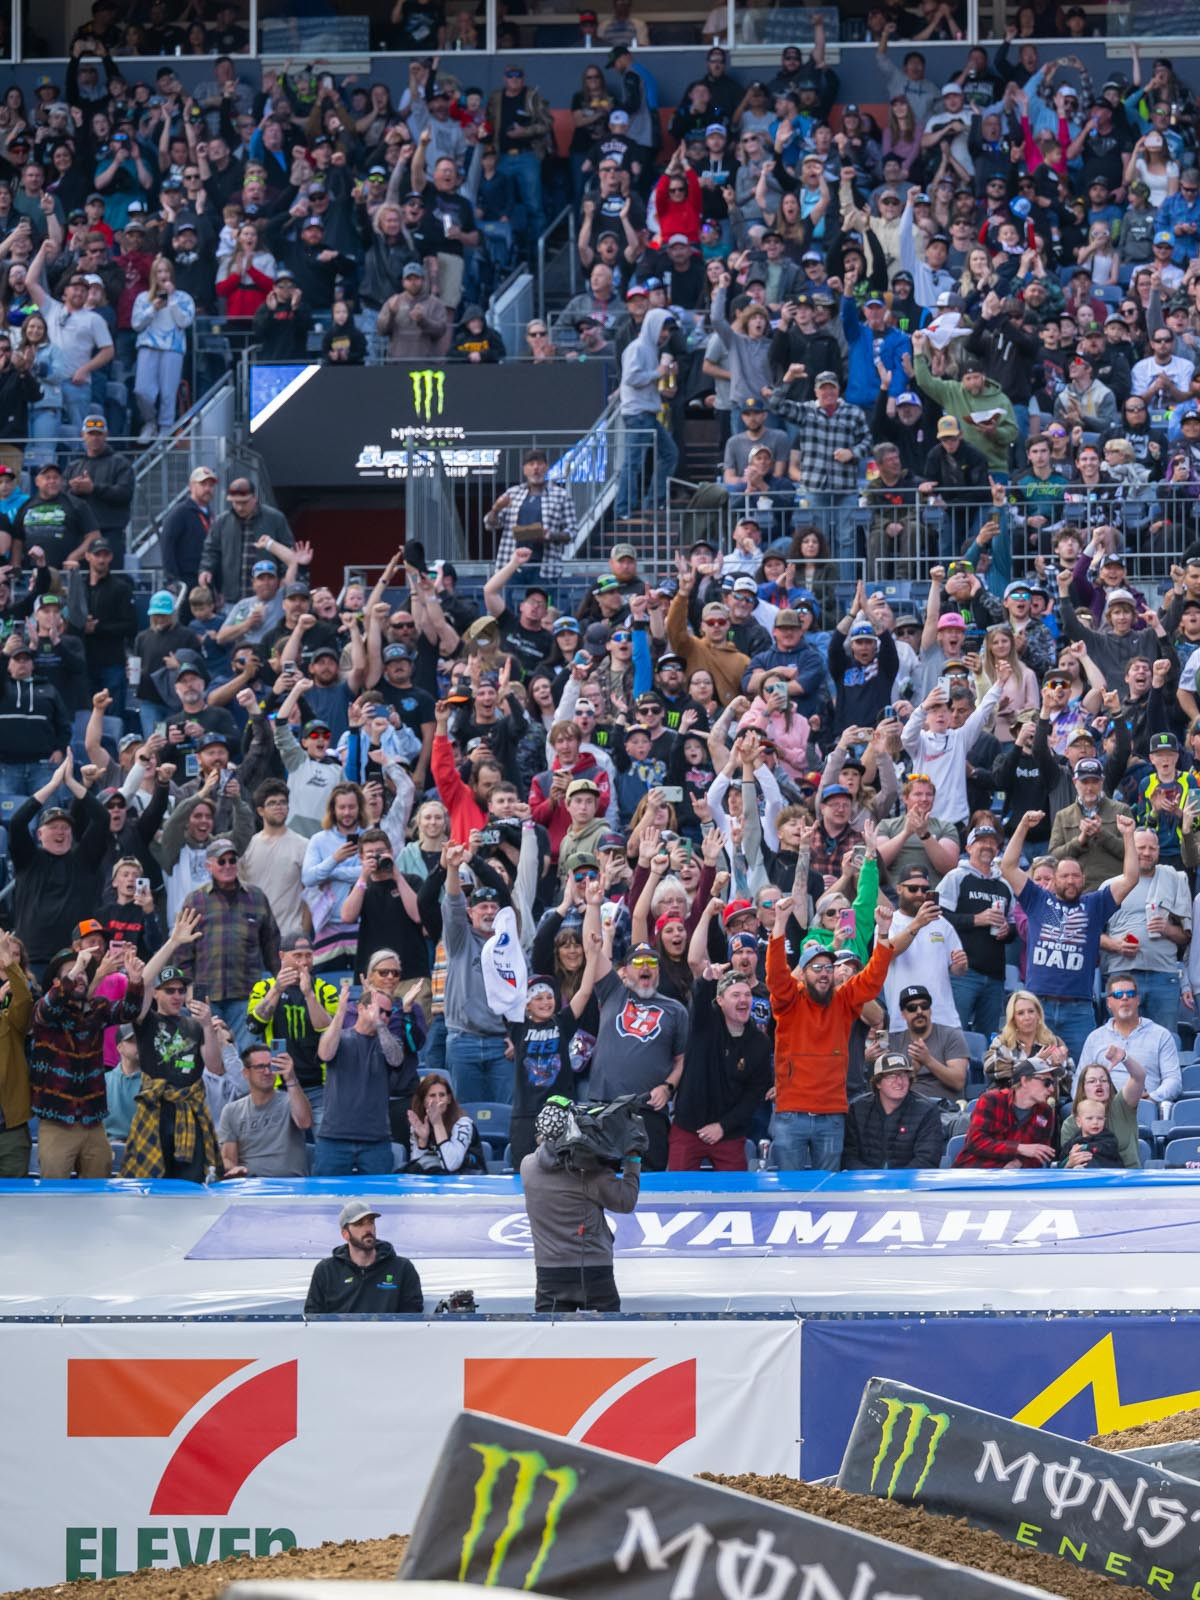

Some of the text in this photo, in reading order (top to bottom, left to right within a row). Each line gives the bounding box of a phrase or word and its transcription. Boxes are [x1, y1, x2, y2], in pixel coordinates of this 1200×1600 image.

[1032, 946, 1084, 971] DAD
[1041, 940, 1077, 952] PROUD
[634, 1209, 1082, 1246] YAMAHA
[66, 1358, 298, 1516] 7
